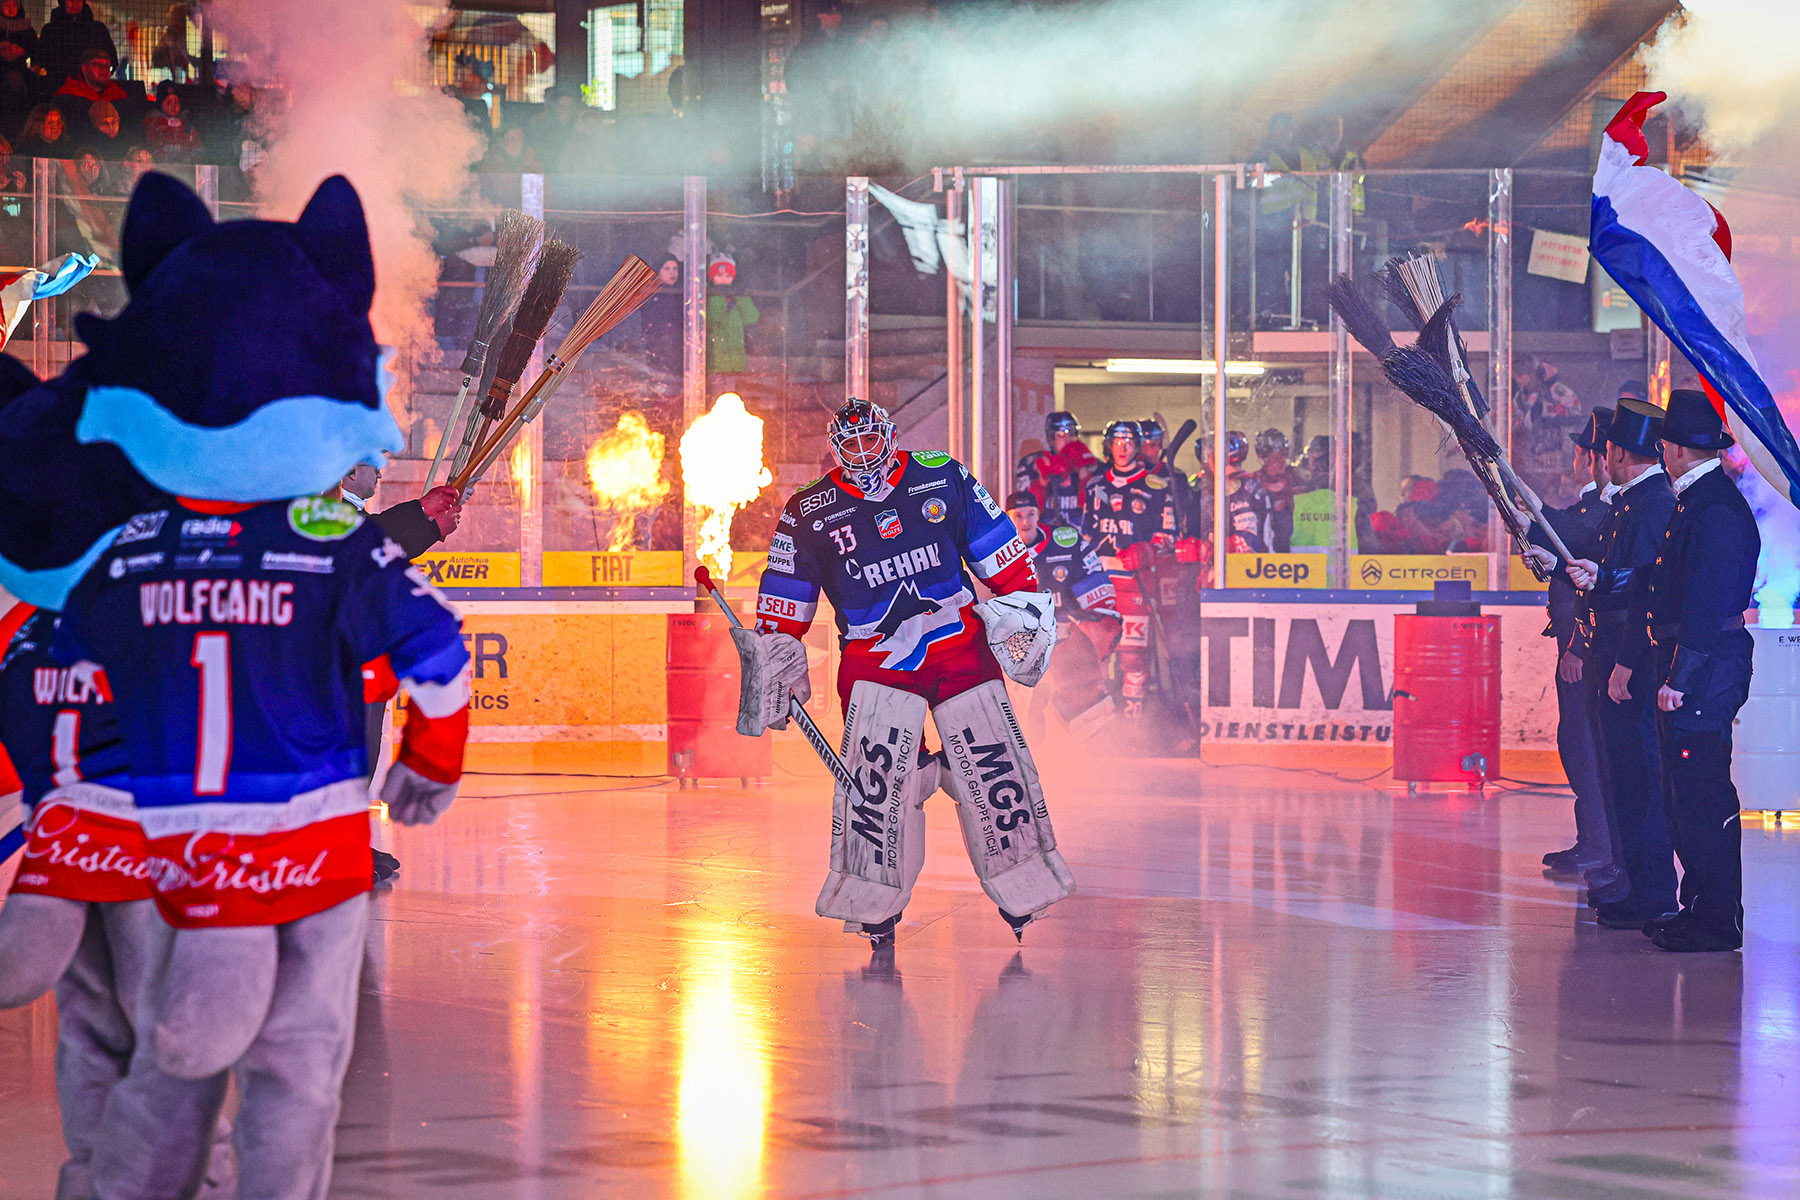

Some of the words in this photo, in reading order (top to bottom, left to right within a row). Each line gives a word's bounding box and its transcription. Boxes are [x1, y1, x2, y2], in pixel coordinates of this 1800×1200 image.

[799, 488, 836, 517] ESM
[181, 518, 232, 536] radio
[829, 524, 858, 556] 33
[449, 556, 489, 564] Autohaus
[592, 556, 634, 582] FIAT
[767, 555, 791, 567] RUPPE
[863, 542, 942, 589] REHAU
[1245, 557, 1309, 584] Jeep
[1388, 564, 1477, 580] CITROËN
[140, 579, 295, 627] WOLFGANG
[765, 597, 797, 617] SELB
[1201, 617, 1394, 711] TIM
[191, 630, 231, 796] 1
[1001, 702, 1026, 749] WARRIOR
[795, 710, 853, 796] WARRIOR
[896, 728, 914, 773] STICHT
[851, 735, 894, 850] MGS
[890, 776, 905, 825] GRUPPE
[949, 734, 973, 777] MOTOR
[968, 781, 990, 823] GRUPPE
[981, 825, 999, 857] STICHT
[970, 742, 1029, 832] MGS
[887, 828, 898, 870] MOTOR
